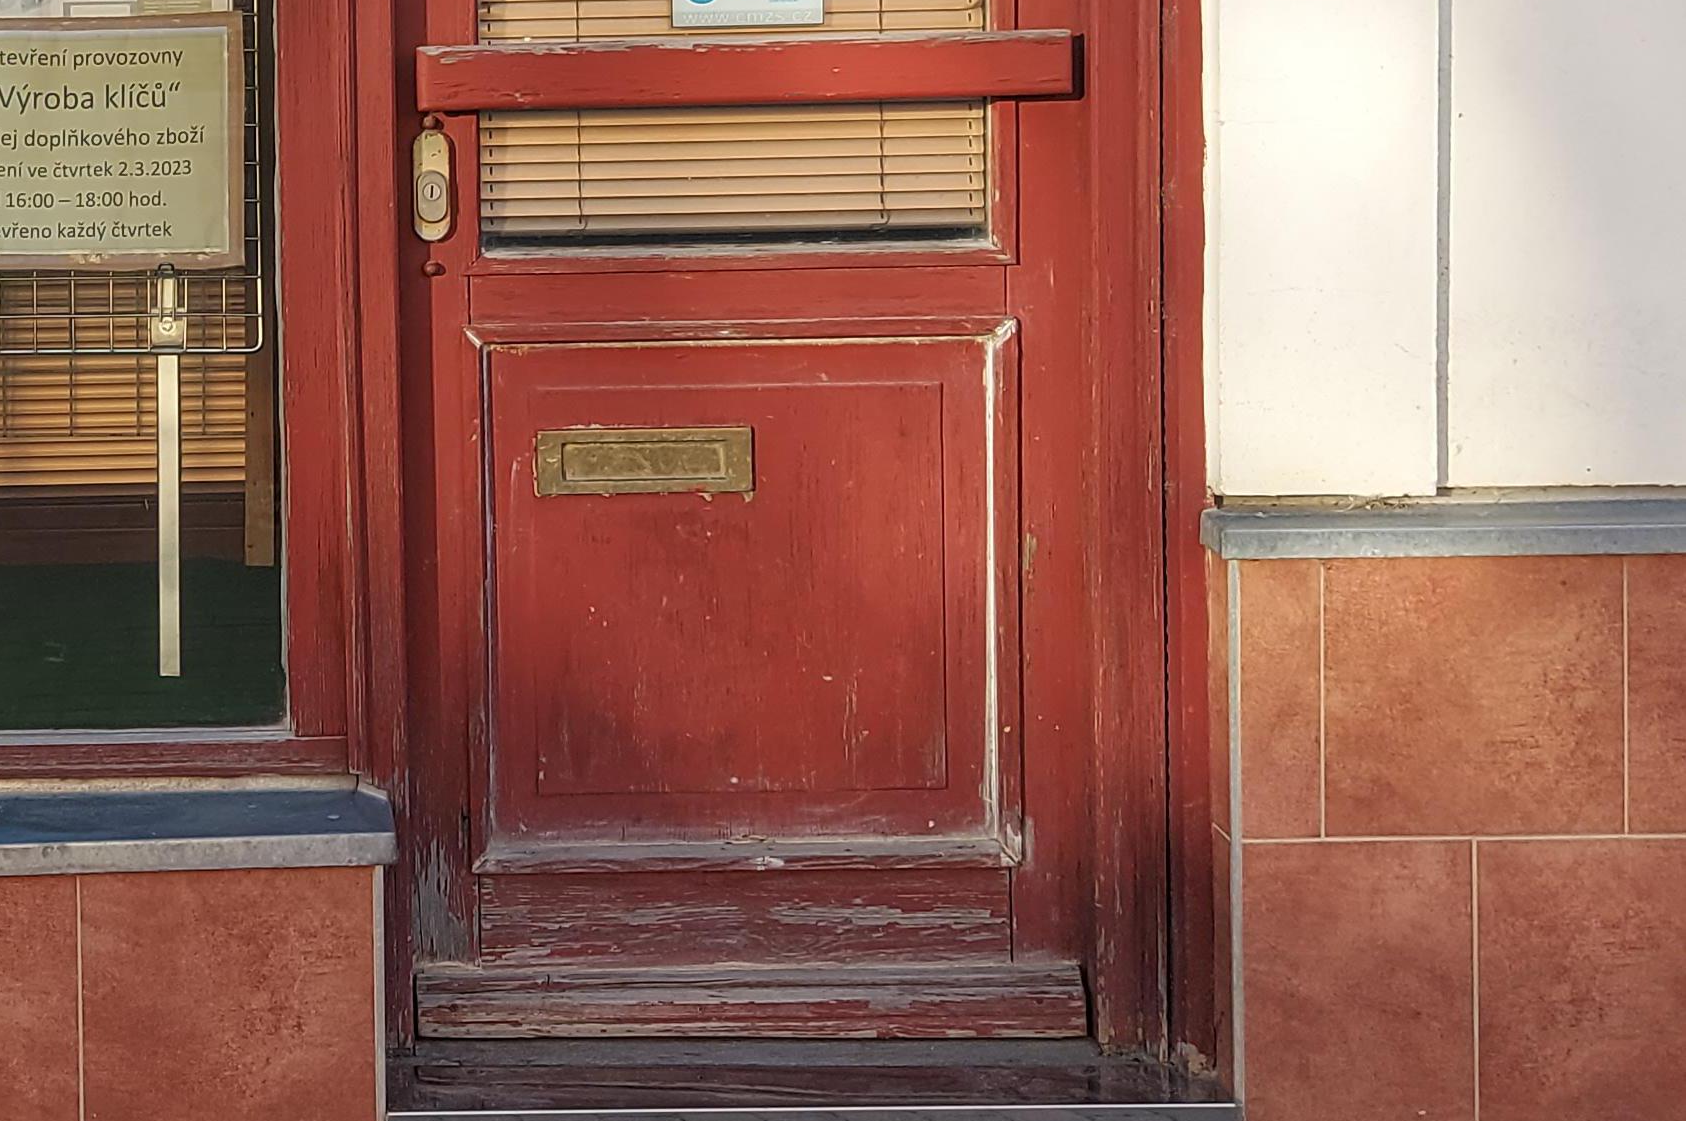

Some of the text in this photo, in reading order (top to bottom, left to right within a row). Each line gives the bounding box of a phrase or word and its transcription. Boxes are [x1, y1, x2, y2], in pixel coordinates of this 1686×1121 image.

[72, 48, 183, 75] provozovny
[23, 127, 150, 151] doplňkového
[156, 125, 205, 146] zboží
[28, 165, 48, 177] ve
[52, 161, 114, 178] čtvrtek
[117, 158, 192, 177] 2.3.2023
[5, 192, 55, 209] 16:00
[74, 191, 124, 208] 18:00
[128, 190, 167, 207] hod.
[57, 221, 107, 242] každý
[111, 220, 172, 239] čtvrtek
